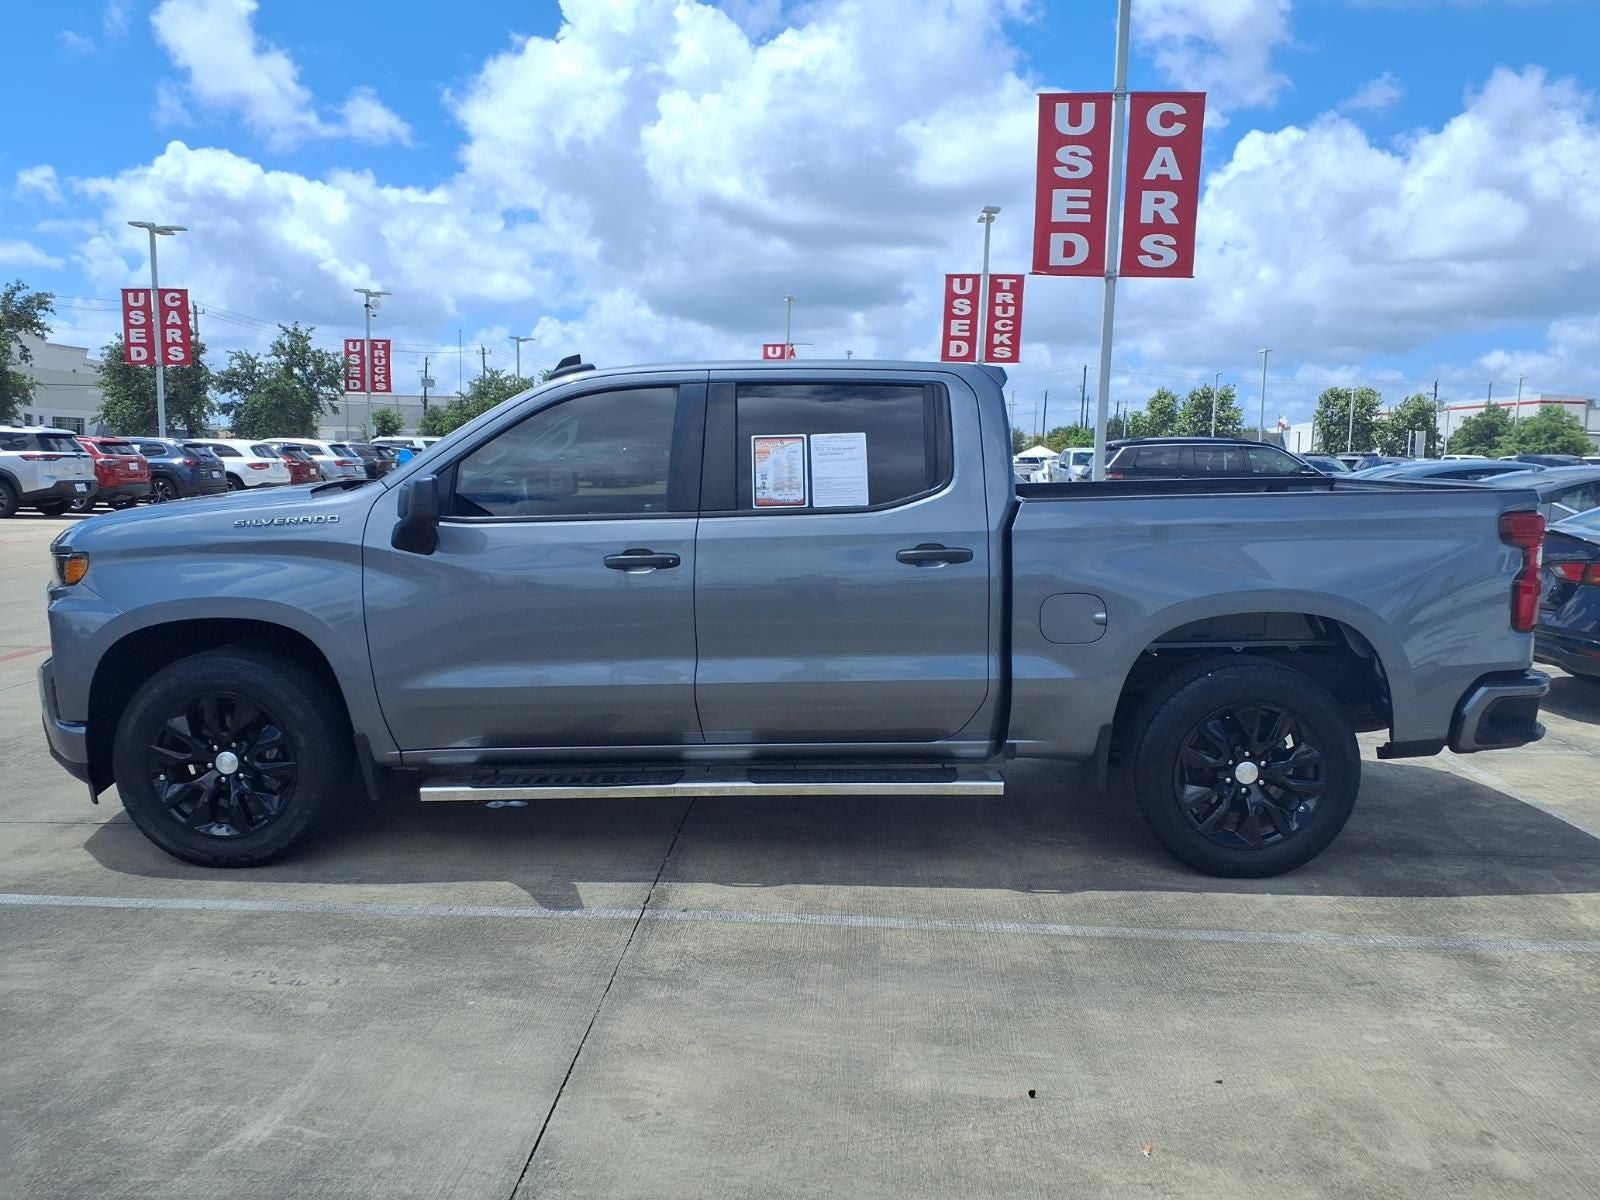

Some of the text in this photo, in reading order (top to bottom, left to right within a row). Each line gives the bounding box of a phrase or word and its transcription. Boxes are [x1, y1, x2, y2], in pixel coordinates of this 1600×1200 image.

[1048, 102, 1096, 266] USED
[1137, 102, 1187, 268] CARS
[127, 292, 148, 361] USED
[164, 292, 185, 361] CARS
[948, 278, 973, 357] USED
[992, 278, 1017, 358] TRUCKS
[348, 341, 361, 390] USED
[374, 341, 387, 390] TRUCKS
[233, 514, 339, 527] SILVERADO
